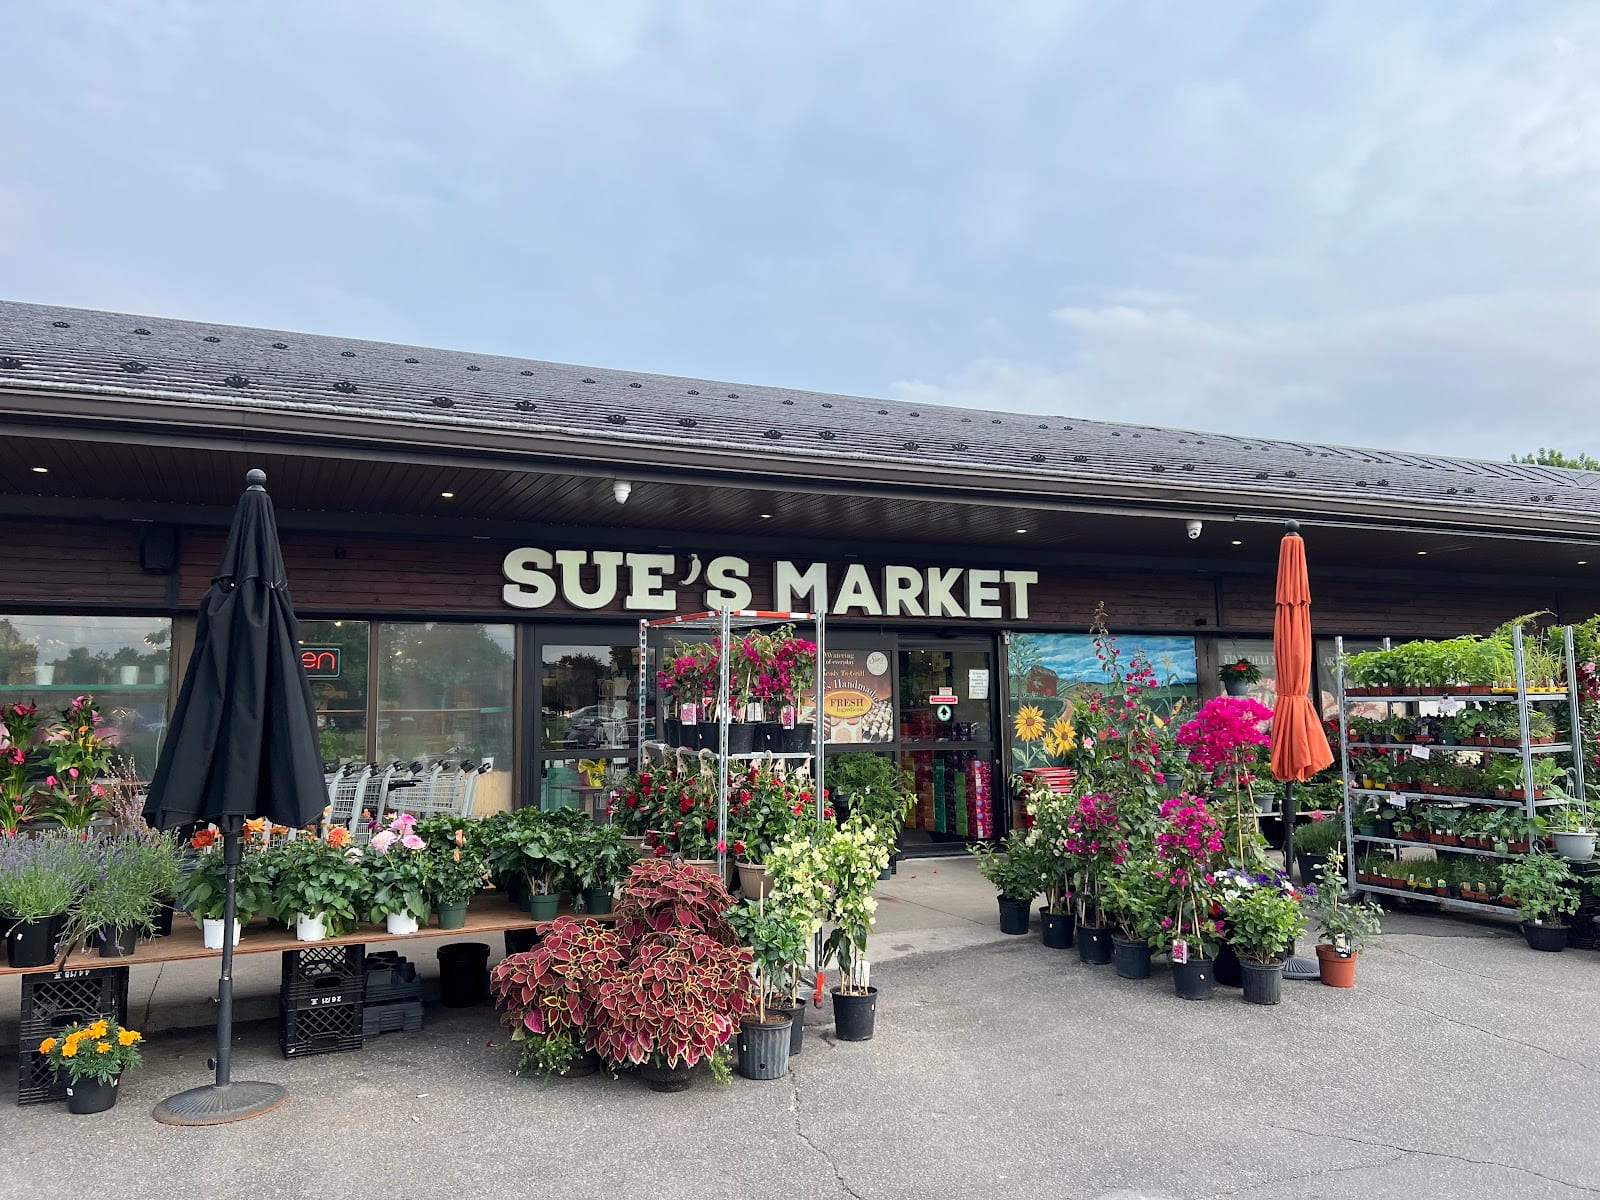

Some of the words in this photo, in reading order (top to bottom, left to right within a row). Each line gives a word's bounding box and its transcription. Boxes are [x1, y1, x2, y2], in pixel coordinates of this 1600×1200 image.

[502, 547, 752, 611] SUE'S
[773, 560, 1038, 619] MARKET
[301, 652, 336, 669] en
[824, 669, 839, 679] eady
[834, 679, 879, 702] Handmade
[830, 698, 863, 707] FRESH
